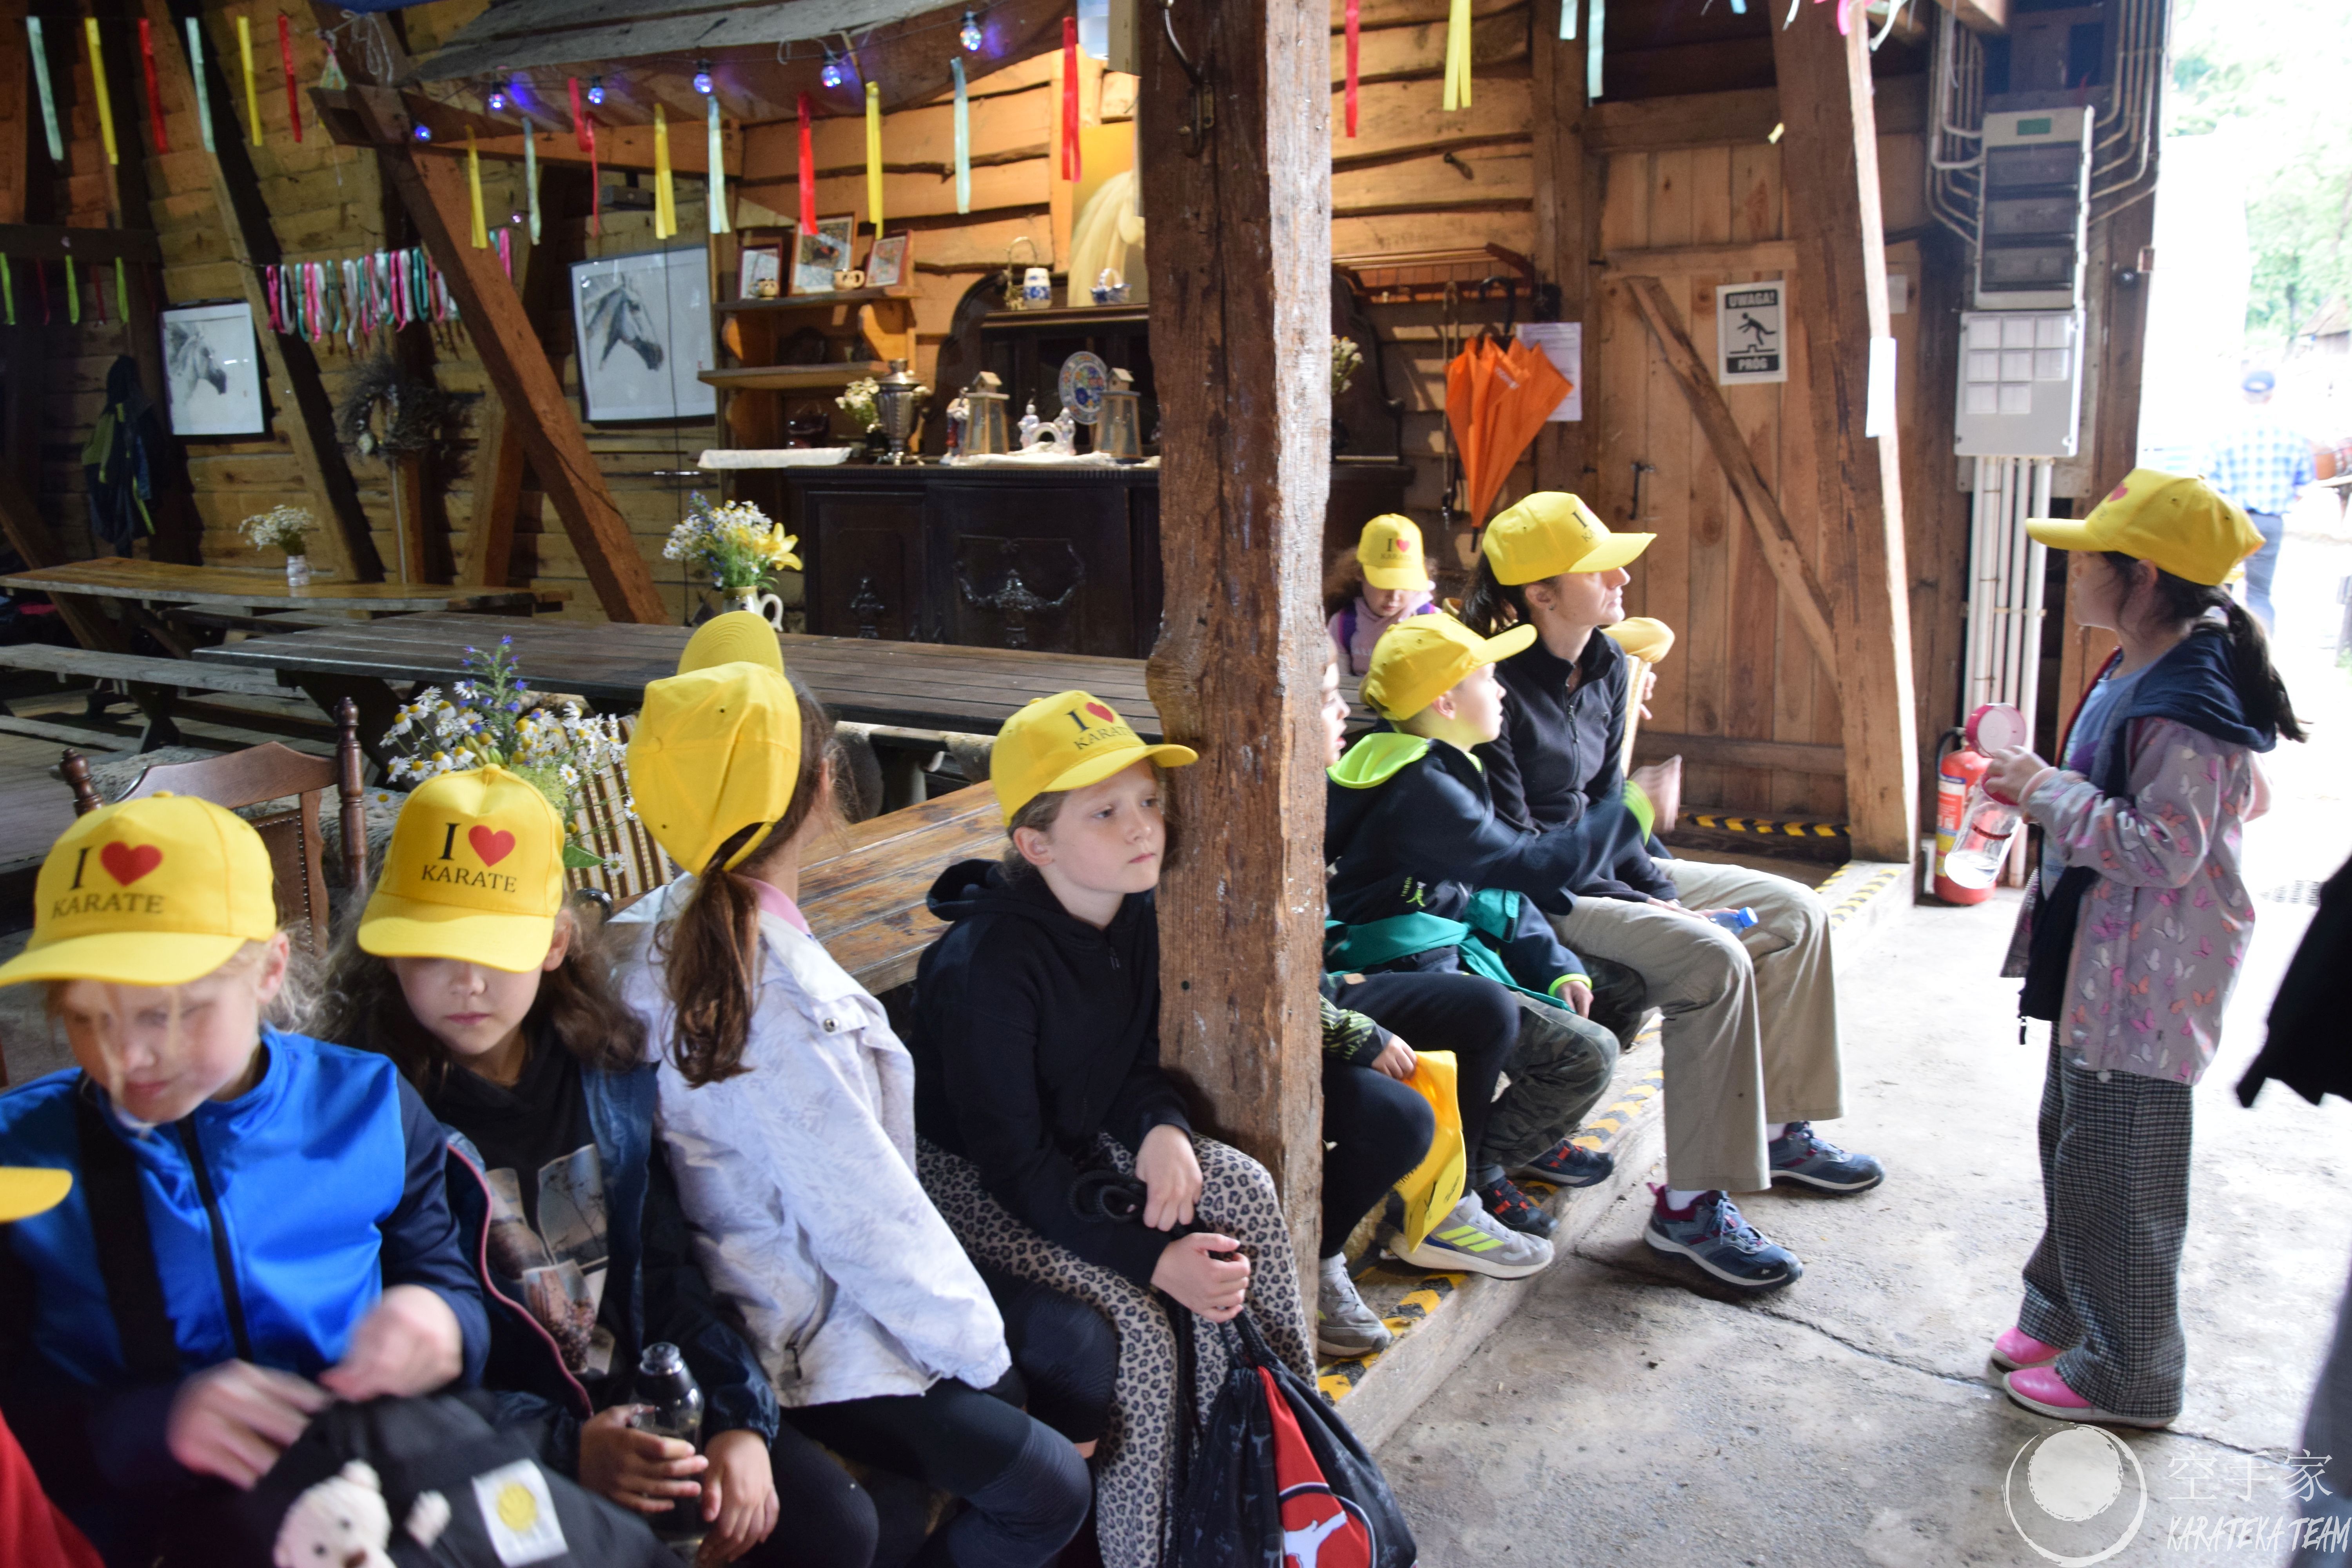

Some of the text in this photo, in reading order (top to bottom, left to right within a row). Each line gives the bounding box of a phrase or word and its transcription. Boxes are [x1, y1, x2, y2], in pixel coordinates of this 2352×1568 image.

[1571, 511, 1588, 528] I
[1387, 538, 1392, 552] I
[1065, 709, 1092, 733] I
[438, 822, 461, 860] I
[69, 845, 94, 891] I
[421, 864, 518, 893] KARATE
[51, 892, 165, 920] KARATE
